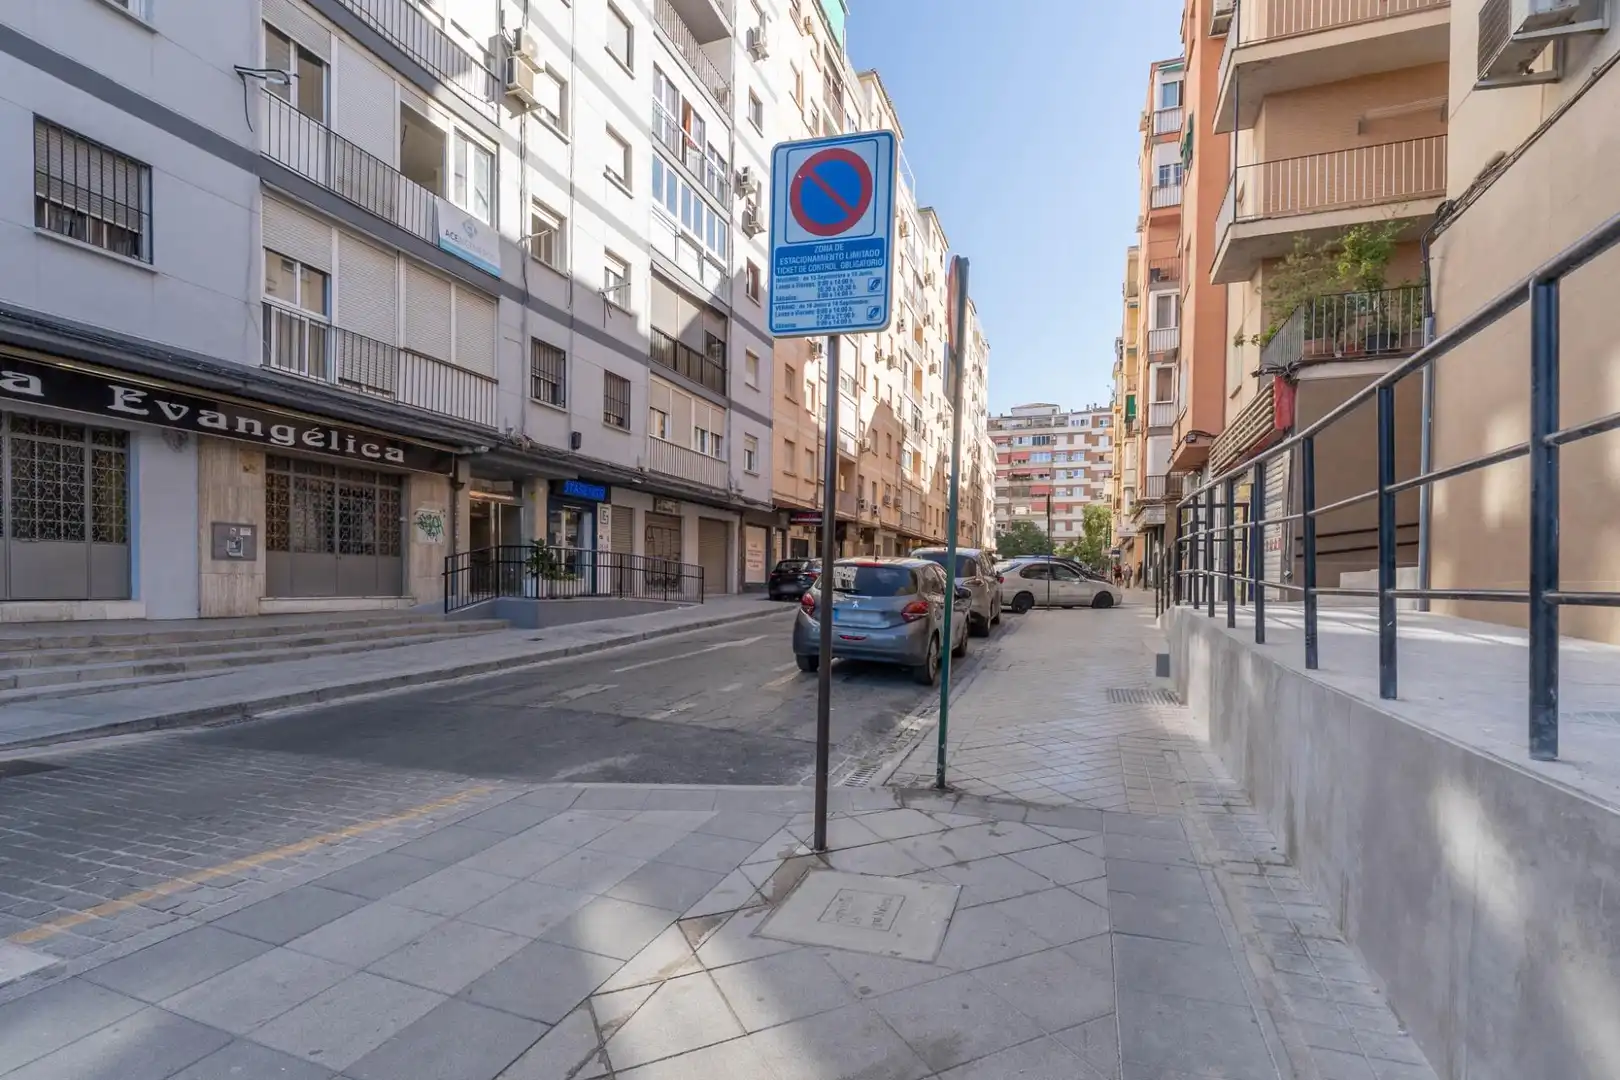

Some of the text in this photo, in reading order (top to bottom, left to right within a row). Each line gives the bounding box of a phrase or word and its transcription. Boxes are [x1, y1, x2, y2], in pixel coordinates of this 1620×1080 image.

[814, 243, 845, 253] ZONA DE
[780, 249, 880, 266] ESTACIONAMIENTO LIMITADO
[777, 258, 883, 274] TICKET DE CONTROL OBLIGATORIO
[107, 384, 405, 463] Evangélica
